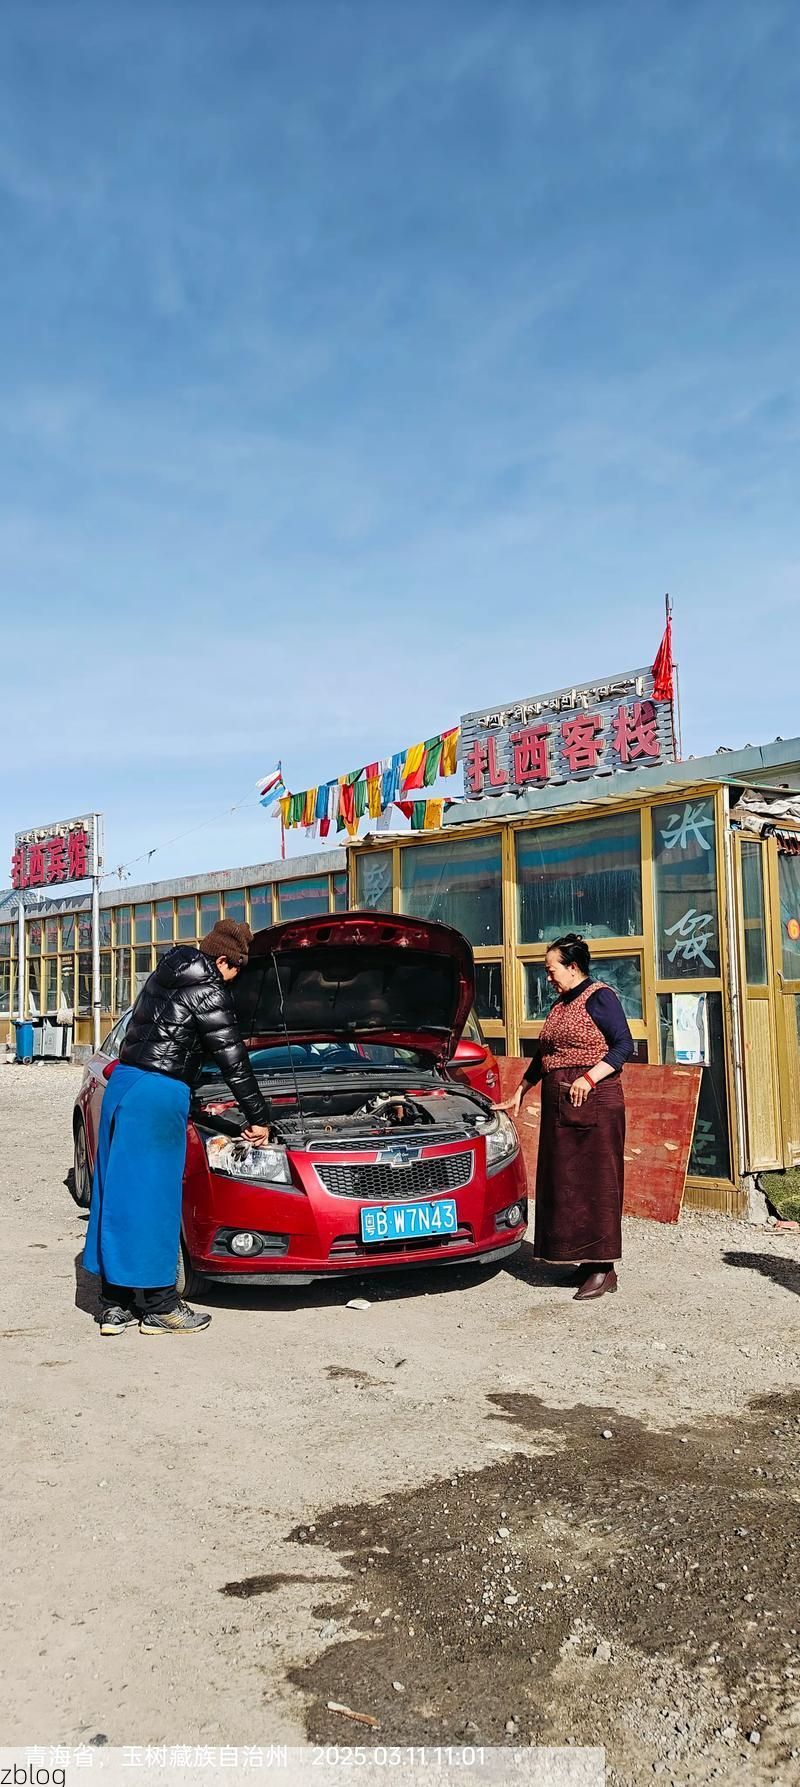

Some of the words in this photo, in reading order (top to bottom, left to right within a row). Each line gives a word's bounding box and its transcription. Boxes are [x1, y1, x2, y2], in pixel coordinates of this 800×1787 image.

[467, 702, 661, 792] 扎西客栈
[11, 831, 87, 889] 扎西宾馆
